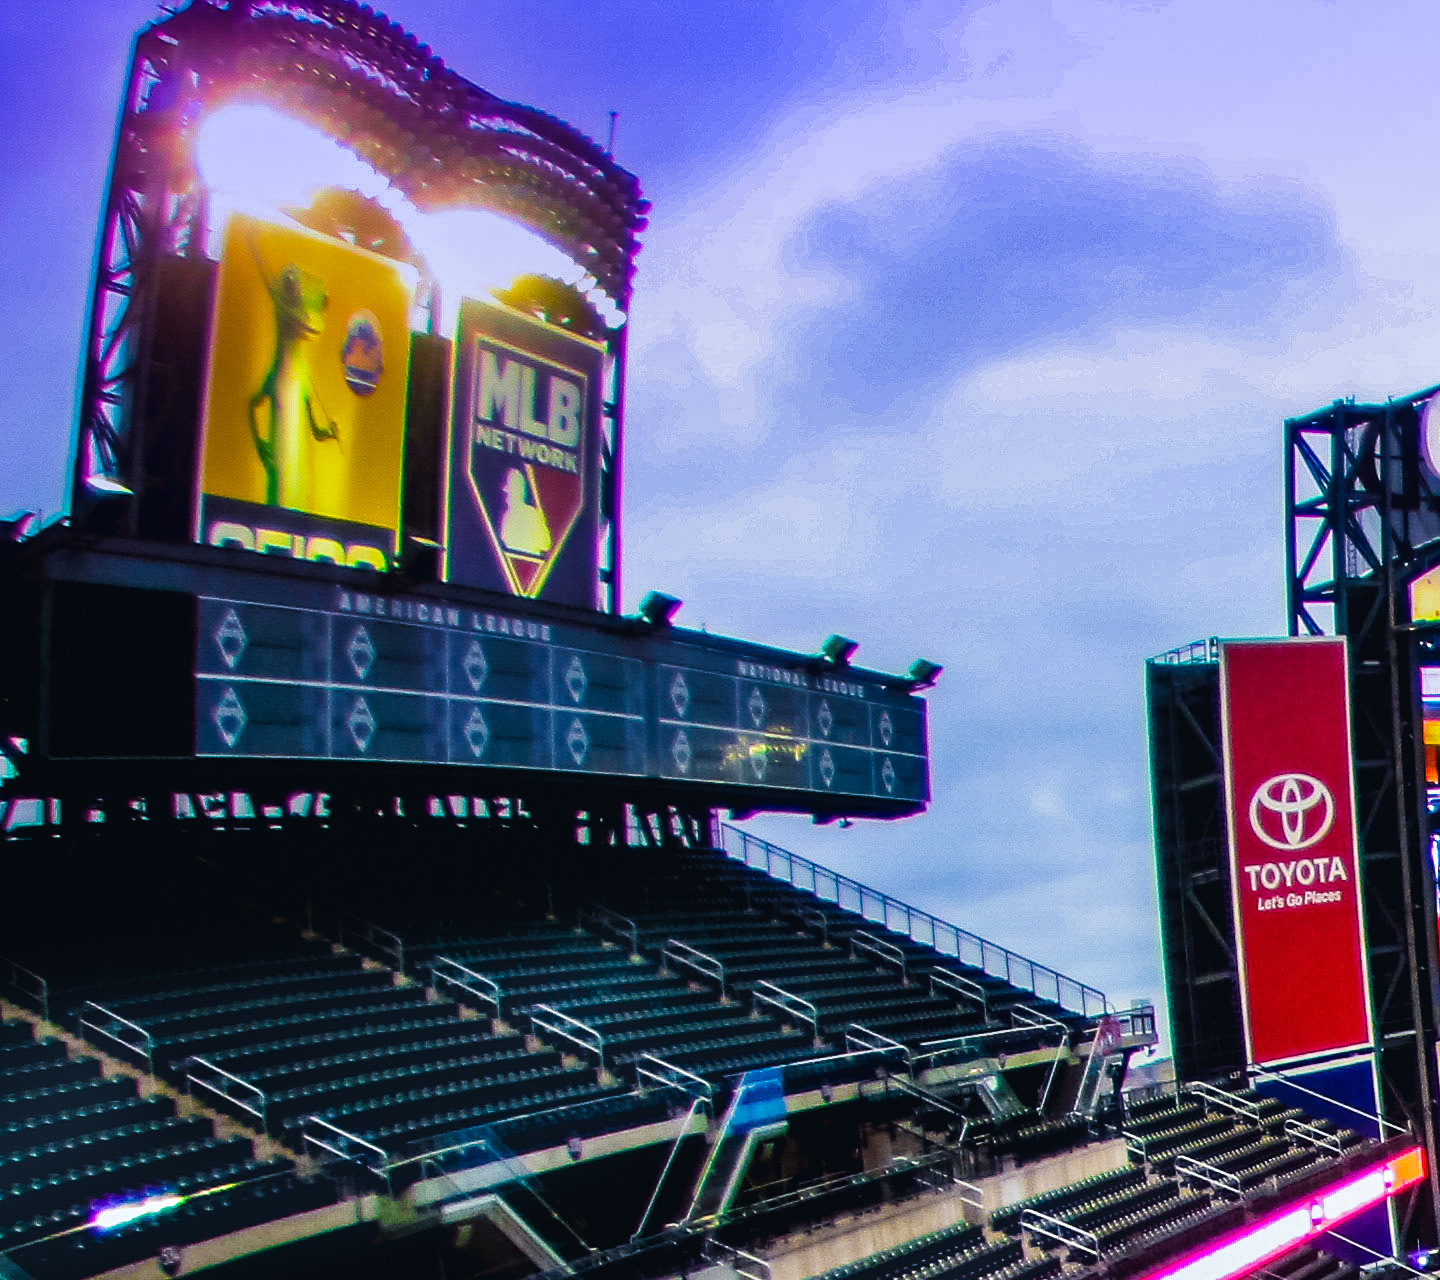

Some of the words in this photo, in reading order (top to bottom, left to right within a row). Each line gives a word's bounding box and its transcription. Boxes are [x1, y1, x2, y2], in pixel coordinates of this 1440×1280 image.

[477, 348, 581, 449] MLB
[475, 426, 579, 474] NETWORK
[339, 591, 460, 627] AMERICAN
[473, 611, 552, 643] LEAGUE
[737, 660, 809, 688] NATIONAL
[815, 679, 865, 698] LEAGUE
[1244, 855, 1348, 892] TOYOTA
[1257, 892, 1283, 911] Let's
[1286, 890, 1302, 909] Go
[1304, 887, 1342, 907] Places
